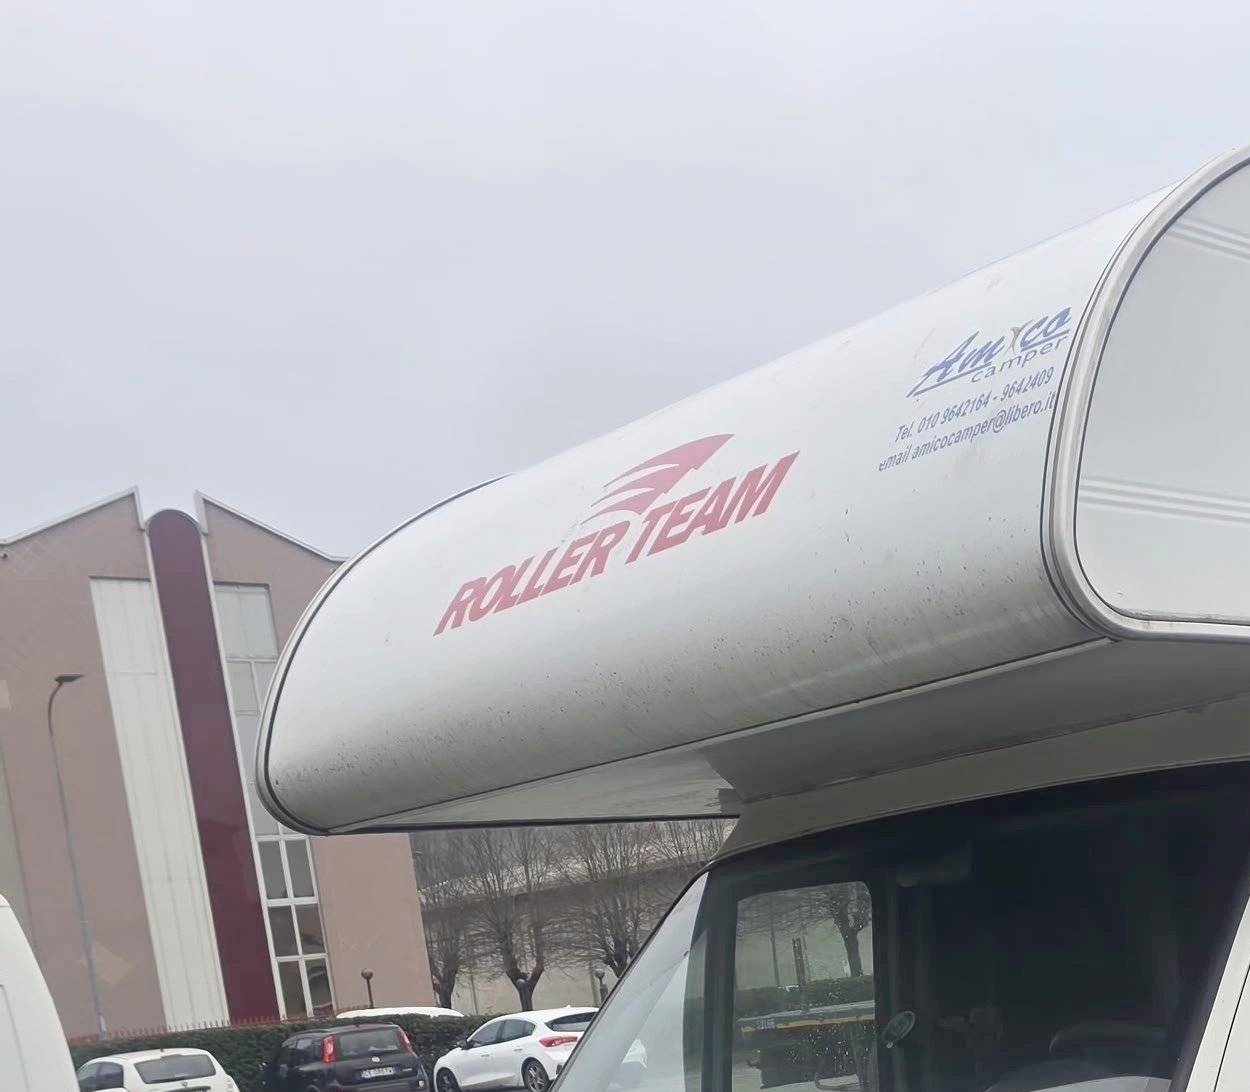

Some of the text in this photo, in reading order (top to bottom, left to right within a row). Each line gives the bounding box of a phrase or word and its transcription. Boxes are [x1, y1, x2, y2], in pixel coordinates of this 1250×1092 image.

[971, 335, 1068, 384] camper
[878, 390, 1056, 473] email amicocamper@libero.it
[894, 421, 913, 443] Tel.
[917, 411, 940, 434] 010
[940, 390, 993, 425] 9642164
[1000, 366, 1055, 402] 9642409
[433, 450, 800, 637] ROLLER TEAM
